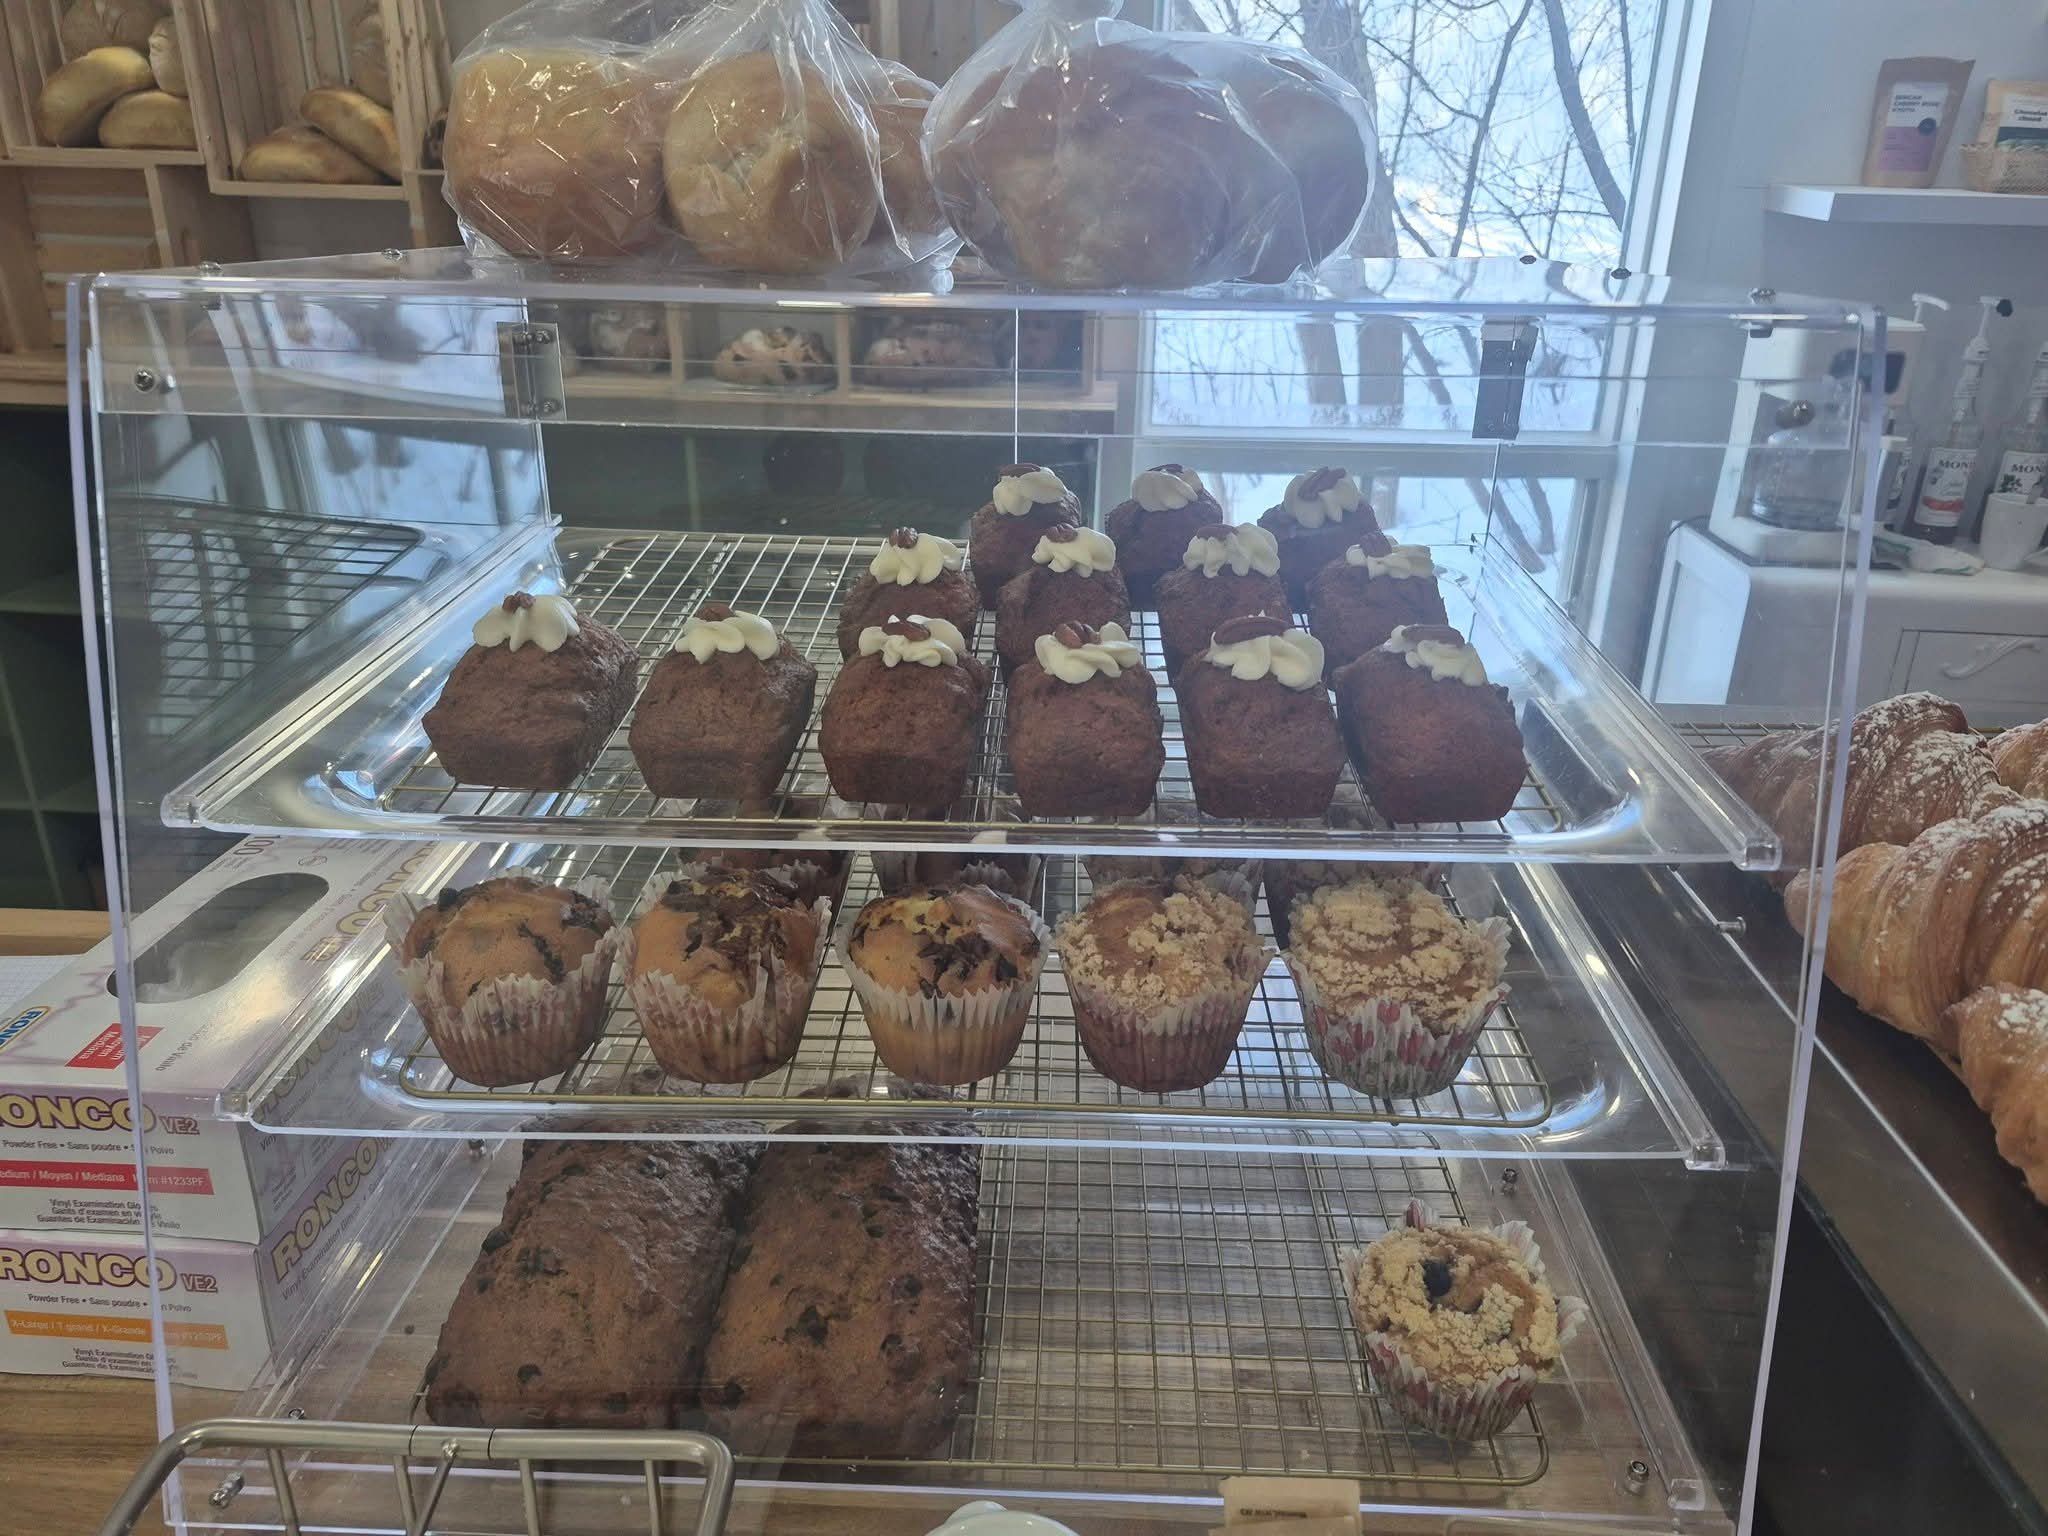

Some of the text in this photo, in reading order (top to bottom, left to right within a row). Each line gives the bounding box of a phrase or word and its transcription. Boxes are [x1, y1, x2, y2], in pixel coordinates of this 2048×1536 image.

[0, 1010, 43, 1049] RON
[0, 1093, 201, 1136] ONCO VE2
[2, 1139, 36, 1150] Powder
[38, 1140, 58, 1150] Free
[67, 1141, 90, 1151] Sans
[91, 1142, 122, 1153] poudre
[0, 1170, 31, 1180] edium
[38, 1170, 73, 1182] Moyen
[82, 1171, 125, 1183] Mediana
[50, 1198, 72, 1209] Vinyl
[73, 1199, 126, 1209] Examination
[271, 1136, 379, 1284] RONCO
[37, 1214, 72, 1224] Guantes
[0, 1248, 218, 1293] RONCO VE2
[27, 1293, 59, 1304] Powder
[61, 1295, 80, 1304] Free
